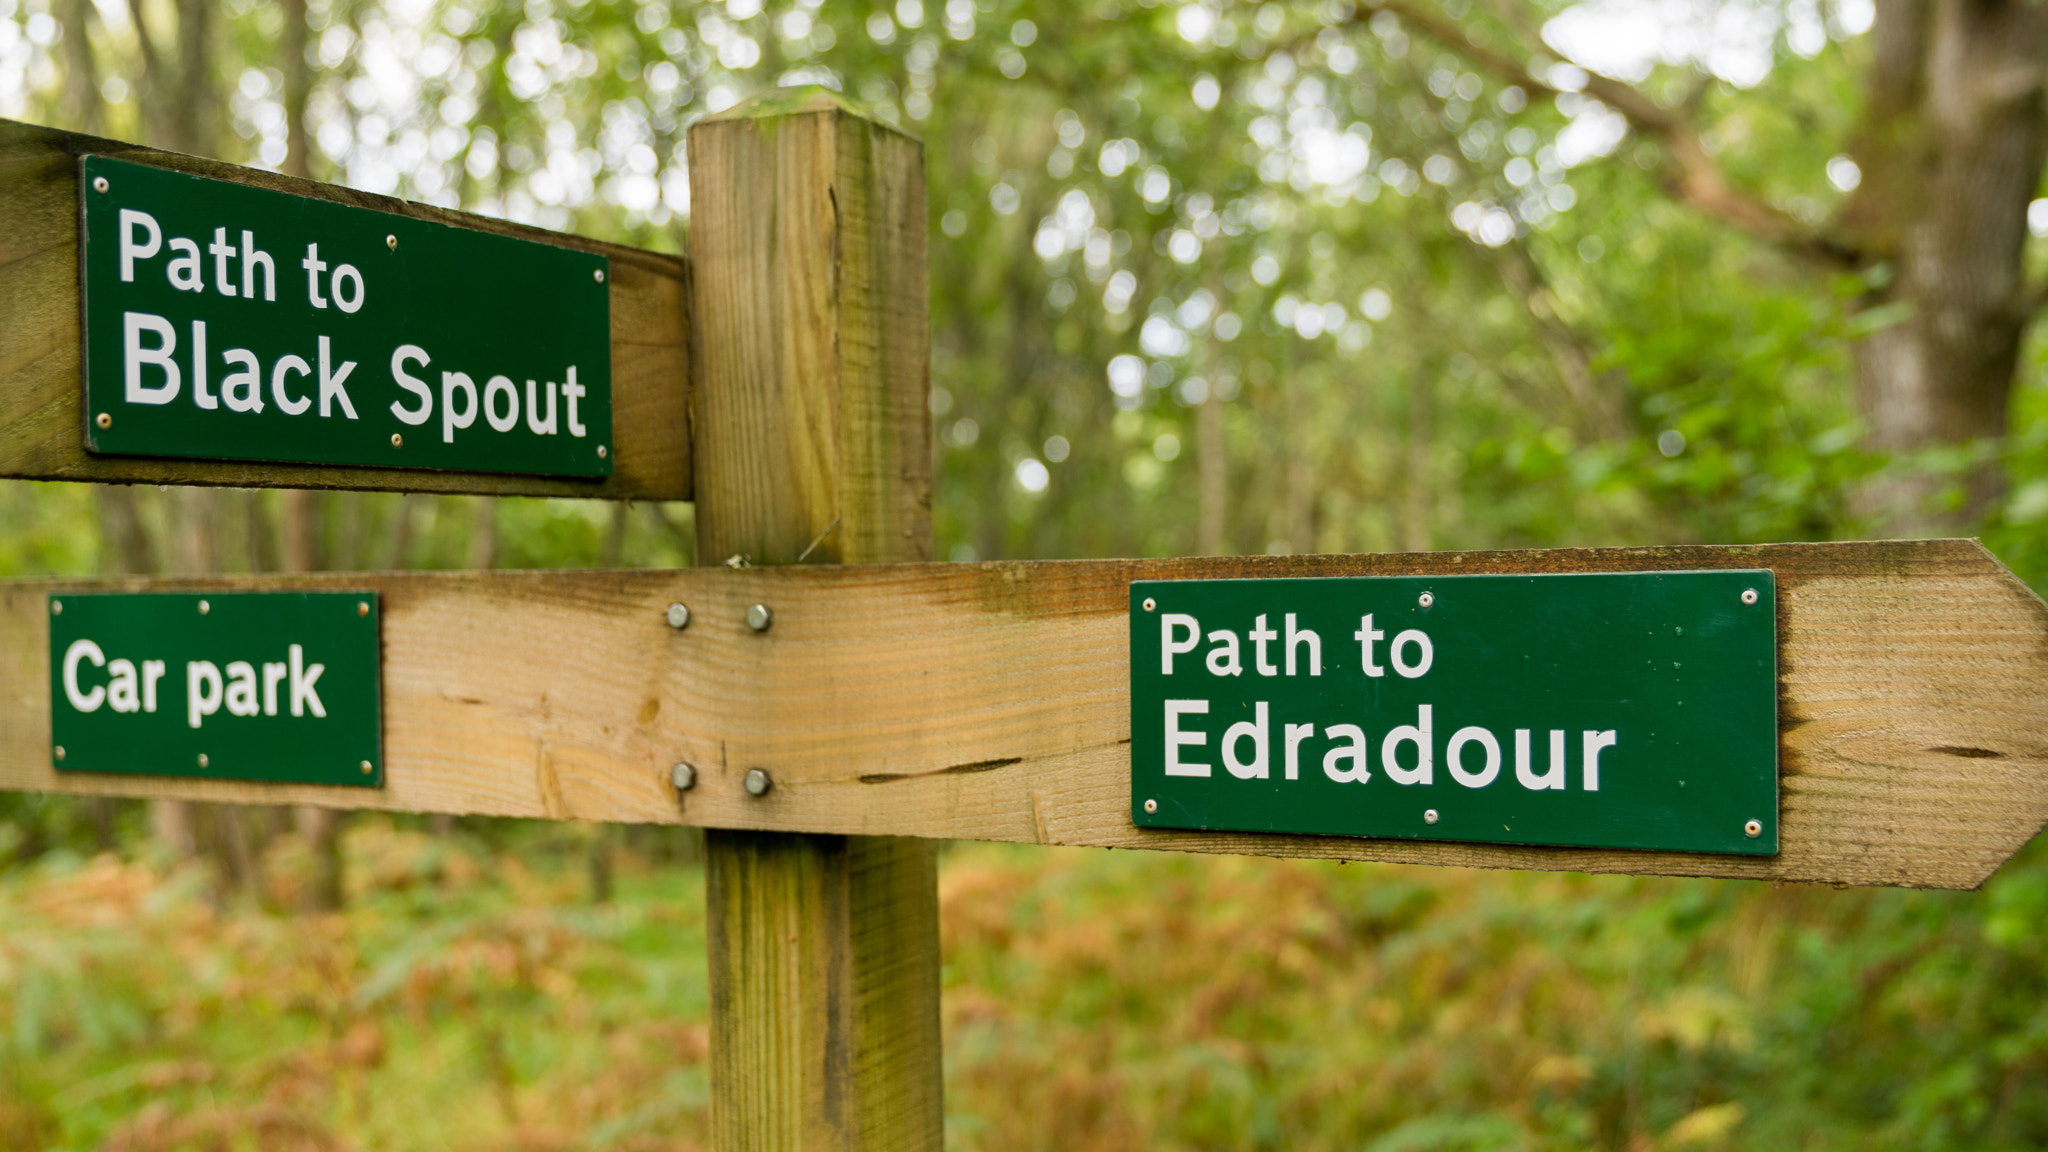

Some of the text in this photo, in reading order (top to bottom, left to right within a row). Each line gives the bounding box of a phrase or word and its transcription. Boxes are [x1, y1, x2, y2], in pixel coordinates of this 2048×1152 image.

[119, 208, 365, 314] Path to
[124, 311, 586, 443] Black Spout
[63, 639, 327, 728] Car park
[1161, 613, 1434, 679] Path to
[1164, 699, 1616, 792] Edradour
